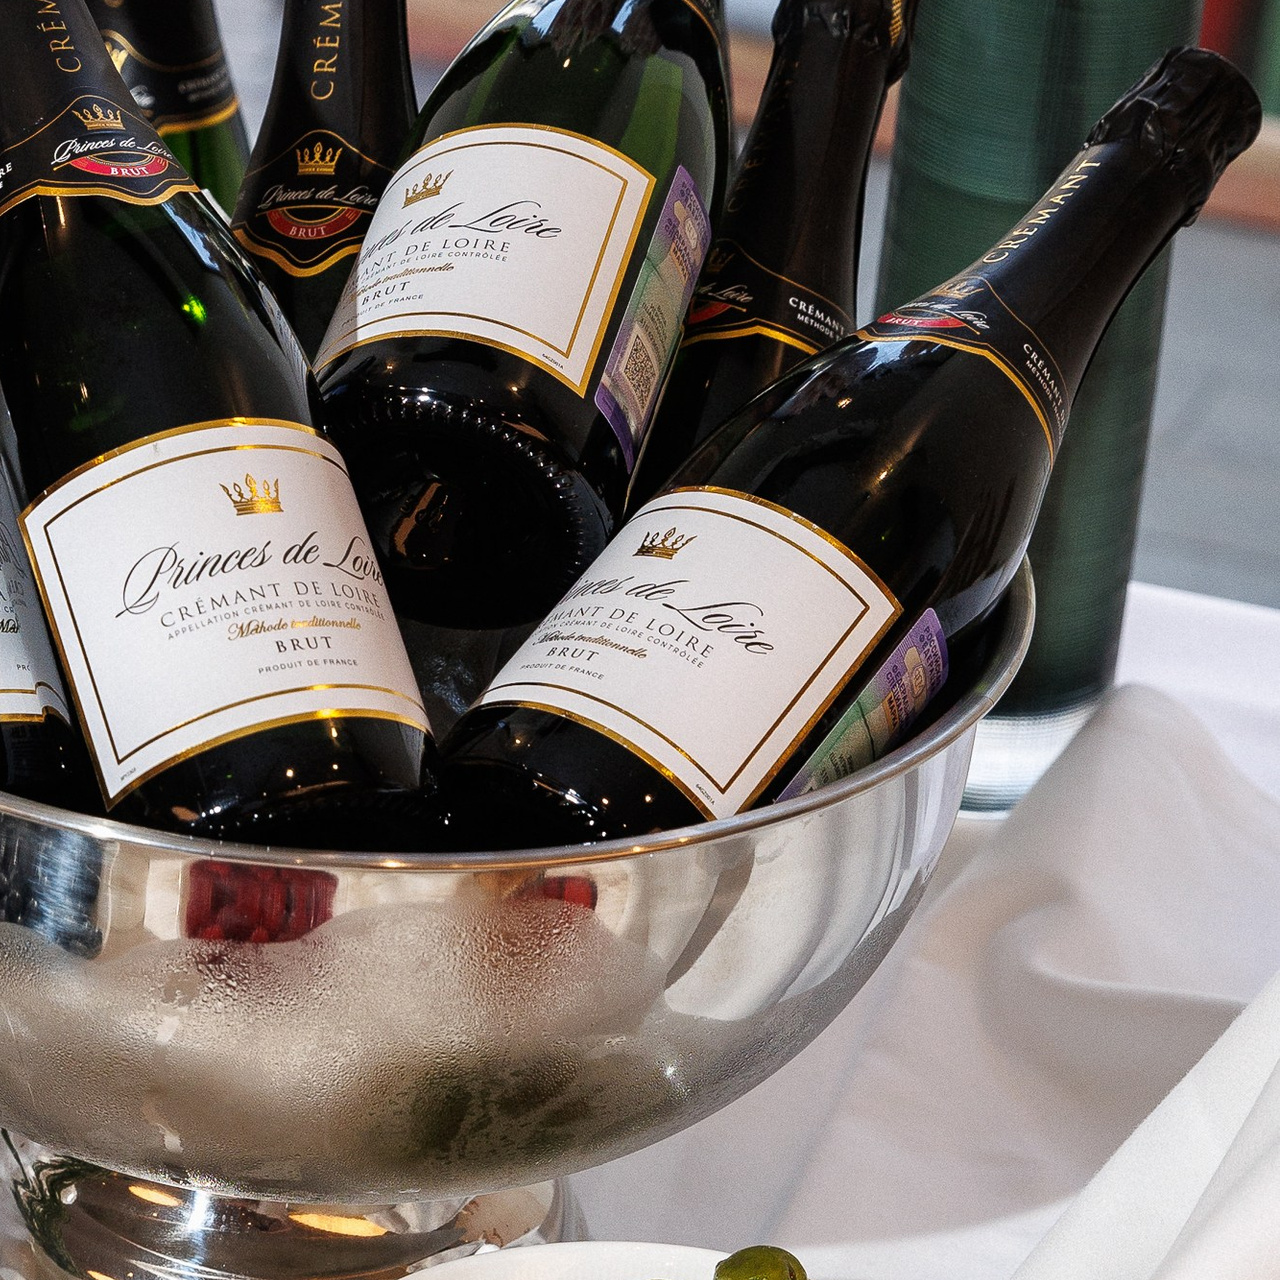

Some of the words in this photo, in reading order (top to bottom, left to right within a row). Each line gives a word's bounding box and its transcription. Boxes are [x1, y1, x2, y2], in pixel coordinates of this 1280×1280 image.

[50, 137, 116, 165] Princes
[119, 137, 137, 149] de
[136, 141, 174, 160] Loire
[110, 166, 150, 177] BRUT
[257, 184, 315, 209] Princes
[315, 184, 338, 200] de
[332, 185, 379, 206] Loire
[410, 201, 465, 235] de
[448, 200, 562, 239] Loire
[982, 159, 1101, 264] CRÉMANT
[289, 226, 327, 238] BRUT
[405, 241, 432, 255] DE
[443, 238, 511, 253] LOIRE
[415, 251, 444, 261] LOIRE
[448, 251, 508, 263] CONTRÔLÉE
[361, 281, 411, 307] BRUT
[389, 294, 424, 305] FRANCE
[788, 296, 846, 336] CRÉMANT
[115, 538, 272, 618] Princes
[281, 531, 322, 567] de
[322, 536, 386, 587] Loire
[159, 581, 282, 628] CRÉMANT
[293, 581, 323, 596] DE
[330, 581, 381, 608] LOIRE
[625, 579, 690, 601] de
[662, 601, 775, 655] Loire
[168, 609, 240, 641] APPELLATION
[244, 599, 295, 616] CRÉMANT
[298, 599, 312, 608] DE
[315, 599, 342, 609] LOIRE
[290, 615, 362, 631] traditionnelle
[275, 636, 333, 654] BRUT
[600, 621, 614, 629] DE
[615, 625, 644, 639] LOIRE
[646, 634, 706, 669] CONTRÔLÉE
[609, 608, 639, 624] DE
[645, 618, 715, 660] LOIRE
[258, 660, 302, 675] PRODUIT
[307, 659, 319, 668] DE
[322, 658, 359, 667] FRANCE
[546, 646, 600, 661] BRUT
[569, 666, 605, 680] FRANCE
[887, 694, 898, 729] МАРКА
